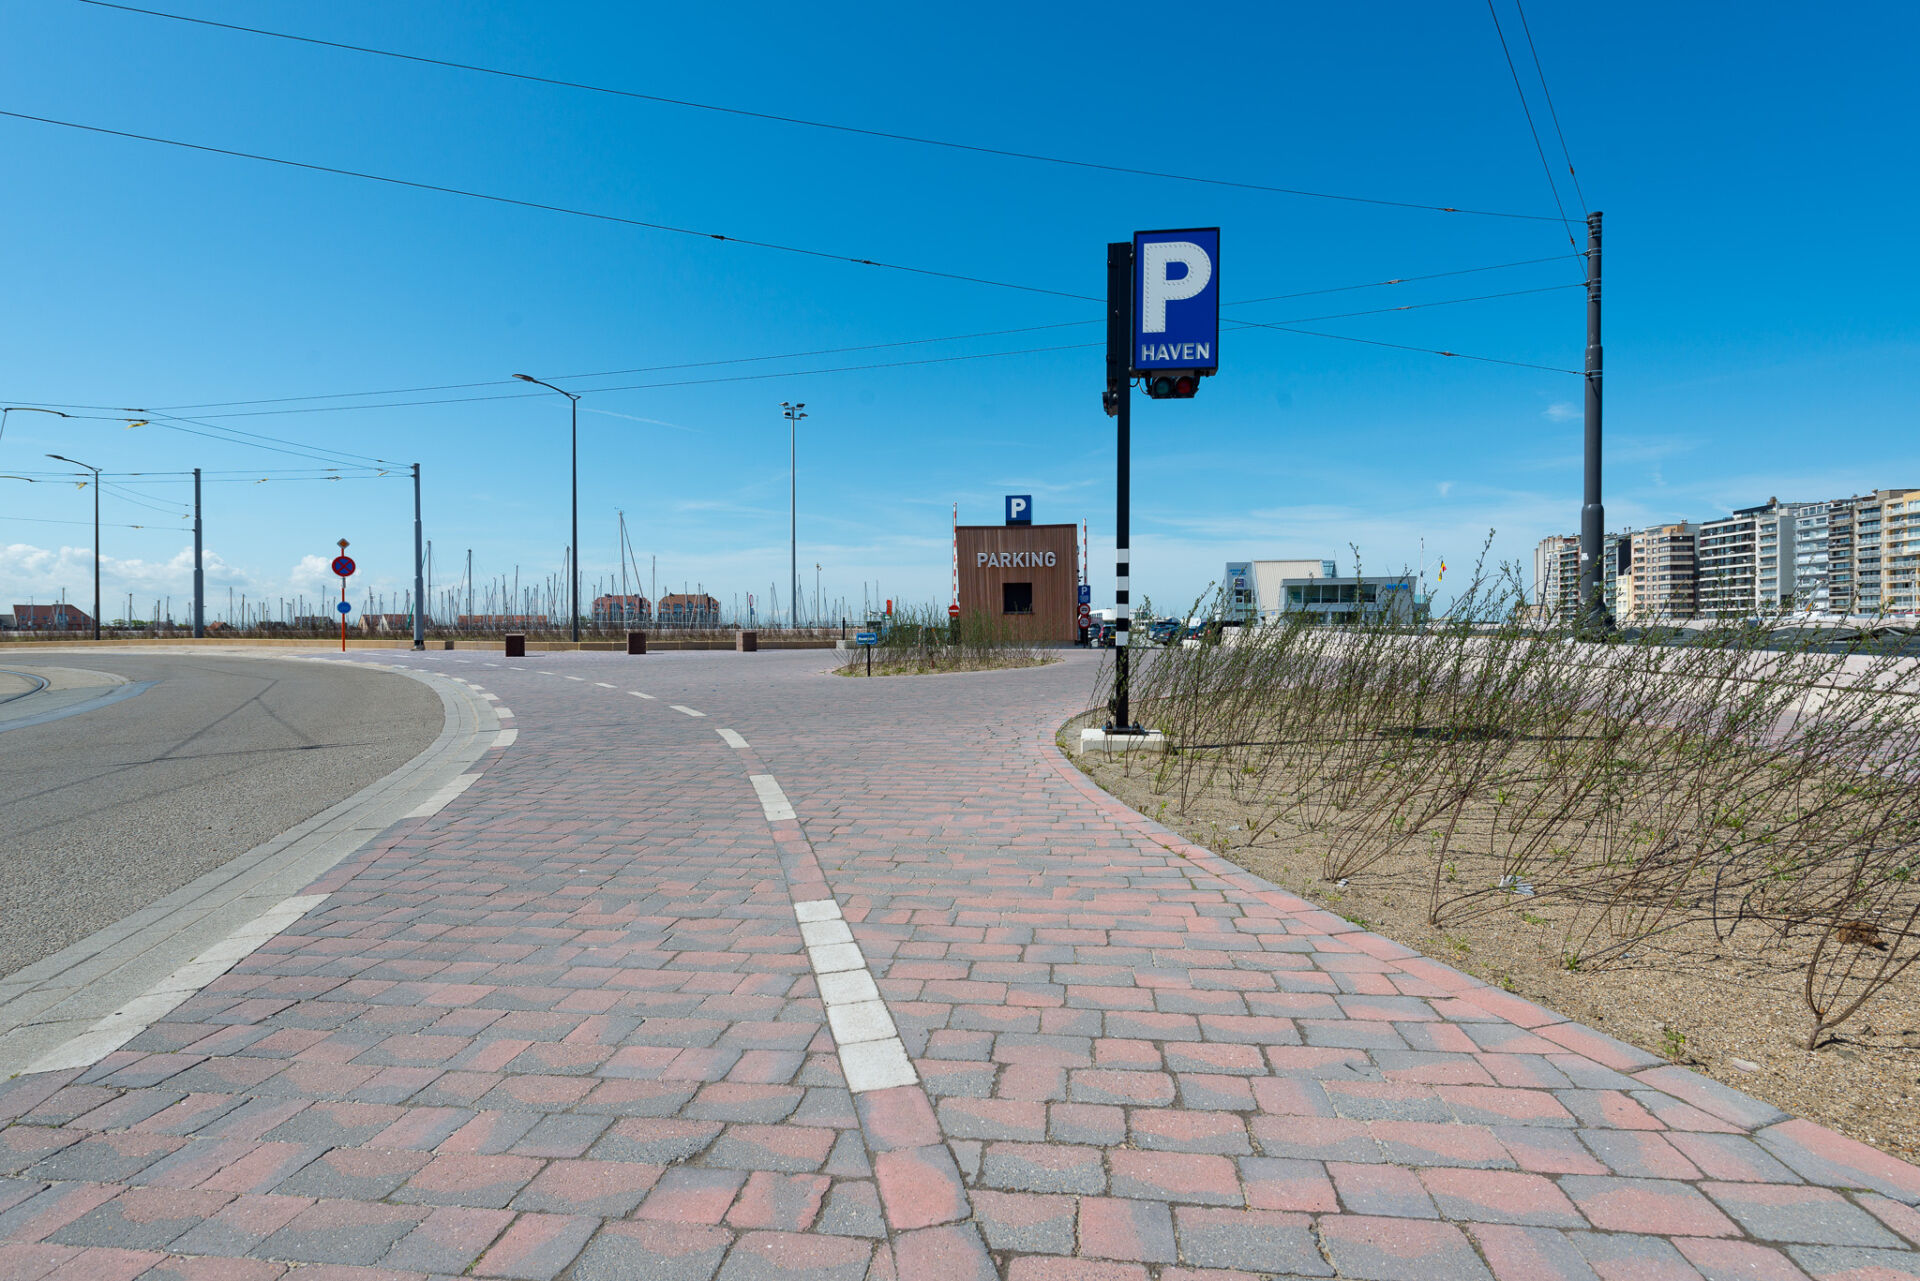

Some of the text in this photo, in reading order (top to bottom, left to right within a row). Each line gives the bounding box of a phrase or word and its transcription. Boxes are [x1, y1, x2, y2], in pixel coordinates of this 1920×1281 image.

[1142, 241, 1212, 333] P
[1141, 342, 1210, 361] HAVEN
[1011, 498, 1026, 518] P
[977, 551, 1056, 568] PARKING
[1081, 586, 1087, 595] P
